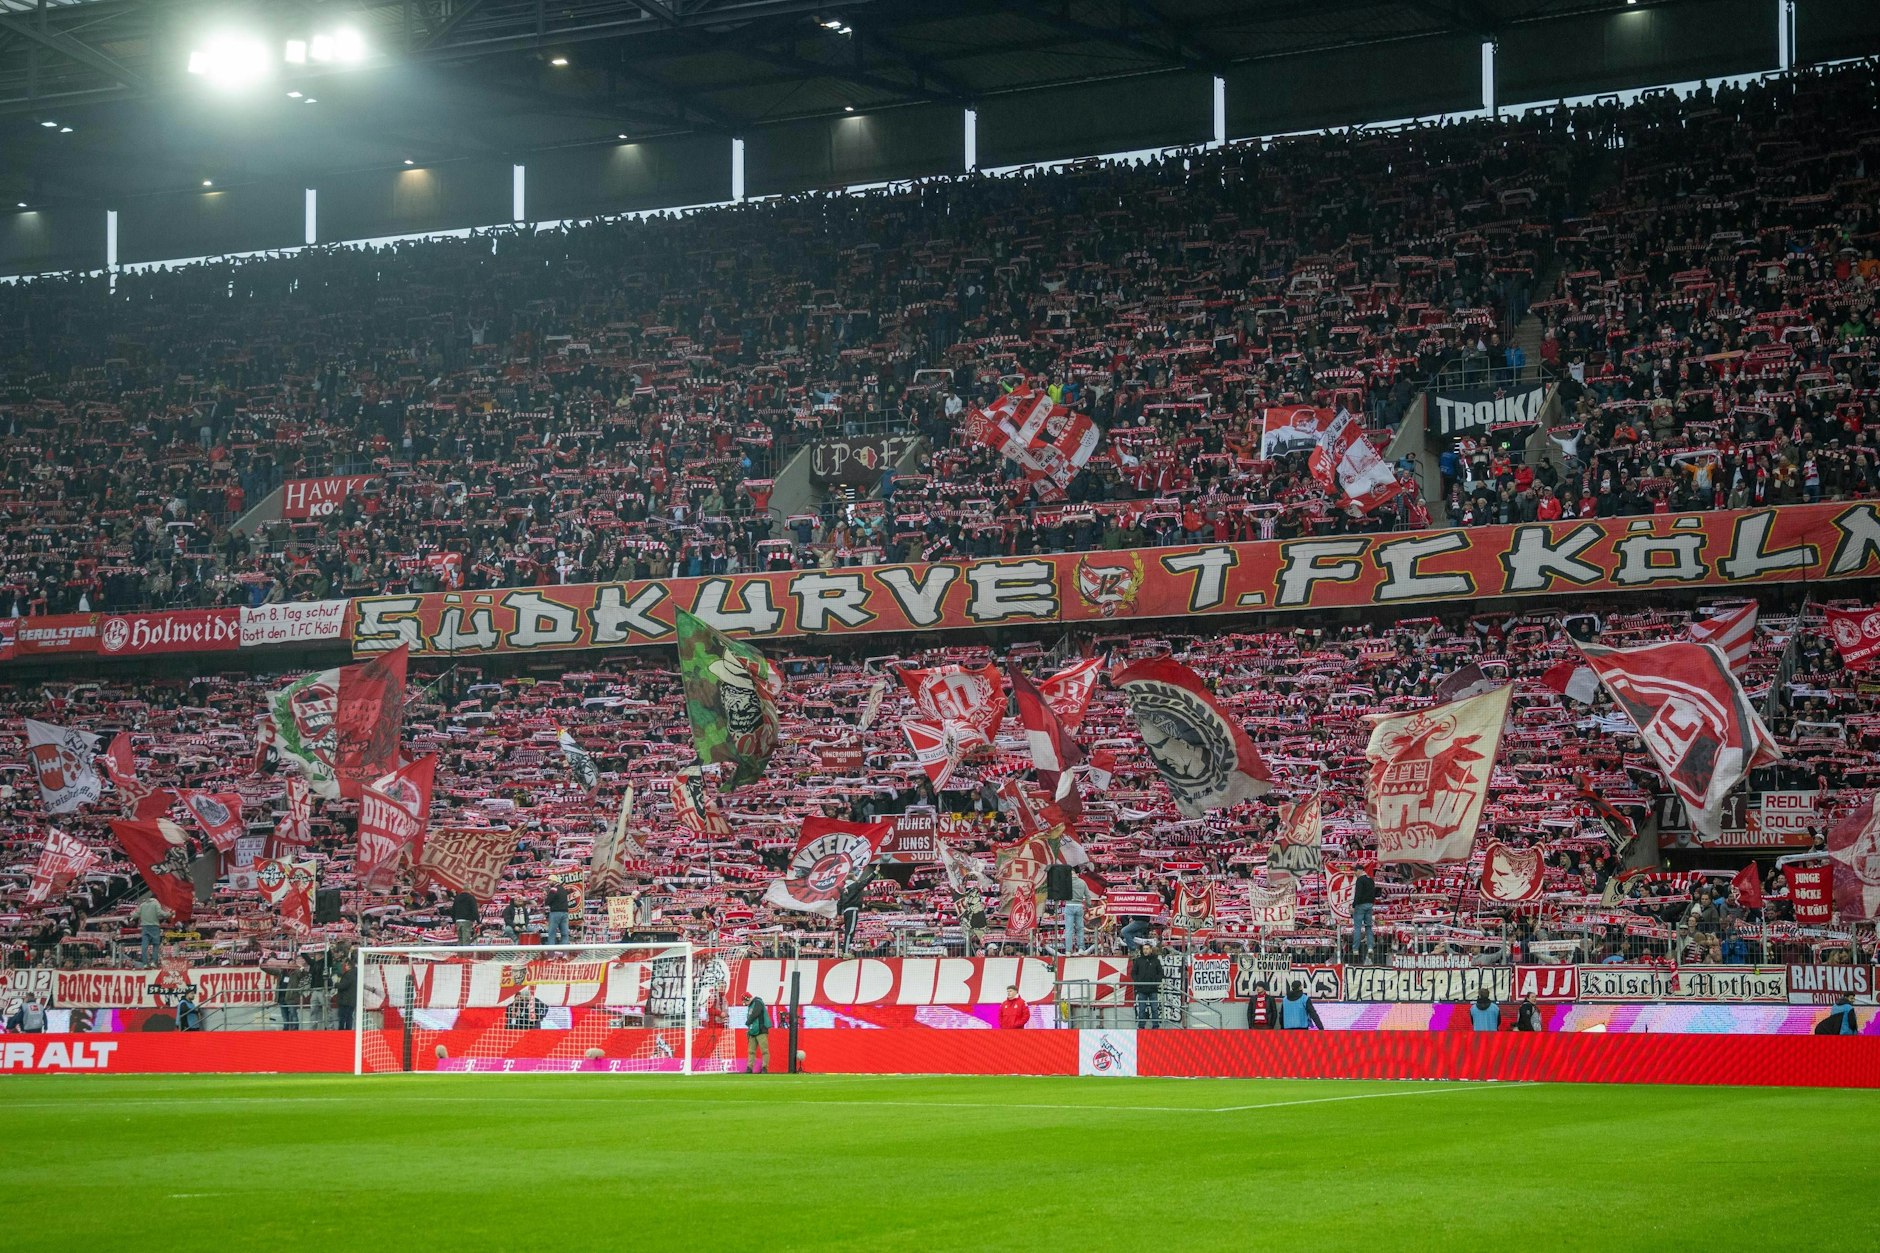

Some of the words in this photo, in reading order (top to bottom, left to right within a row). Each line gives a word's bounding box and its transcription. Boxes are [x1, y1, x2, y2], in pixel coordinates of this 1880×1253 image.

[1436, 387, 1543, 435] TROIKA
[310, 499, 340, 516] KÖ
[247, 611, 265, 623] Am
[270, 608, 279, 621] 8.
[283, 607, 302, 622] Tag
[306, 604, 340, 618] schuf
[353, 560, 1060, 656] SÜDKURVE
[19, 626, 96, 641] GEROLSTEIN
[131, 615, 240, 650] Holweide
[242, 627, 264, 641] Gott
[268, 626, 286, 639] den
[314, 621, 338, 635] Köln
[1766, 815, 1808, 829] COLO
[898, 836, 930, 850] JUNGS
[1795, 872, 1821, 885] JUNGE
[1795, 888, 1822, 900] BÖCKE
[1806, 904, 1829, 916] KÖLN
[57, 974, 146, 1005] DOMSTADT
[746, 957, 1133, 1006] HORDE
[1194, 971, 1230, 985] GEGEN
[1346, 967, 1511, 1002] VEEDELSRADAU
[1524, 969, 1572, 998] AJJ
[1685, 971, 1783, 1000] Mythos
[1791, 965, 1868, 993] RAFIKIS
[0, 1042, 35, 1068] R
[37, 1042, 118, 1068] ALT
